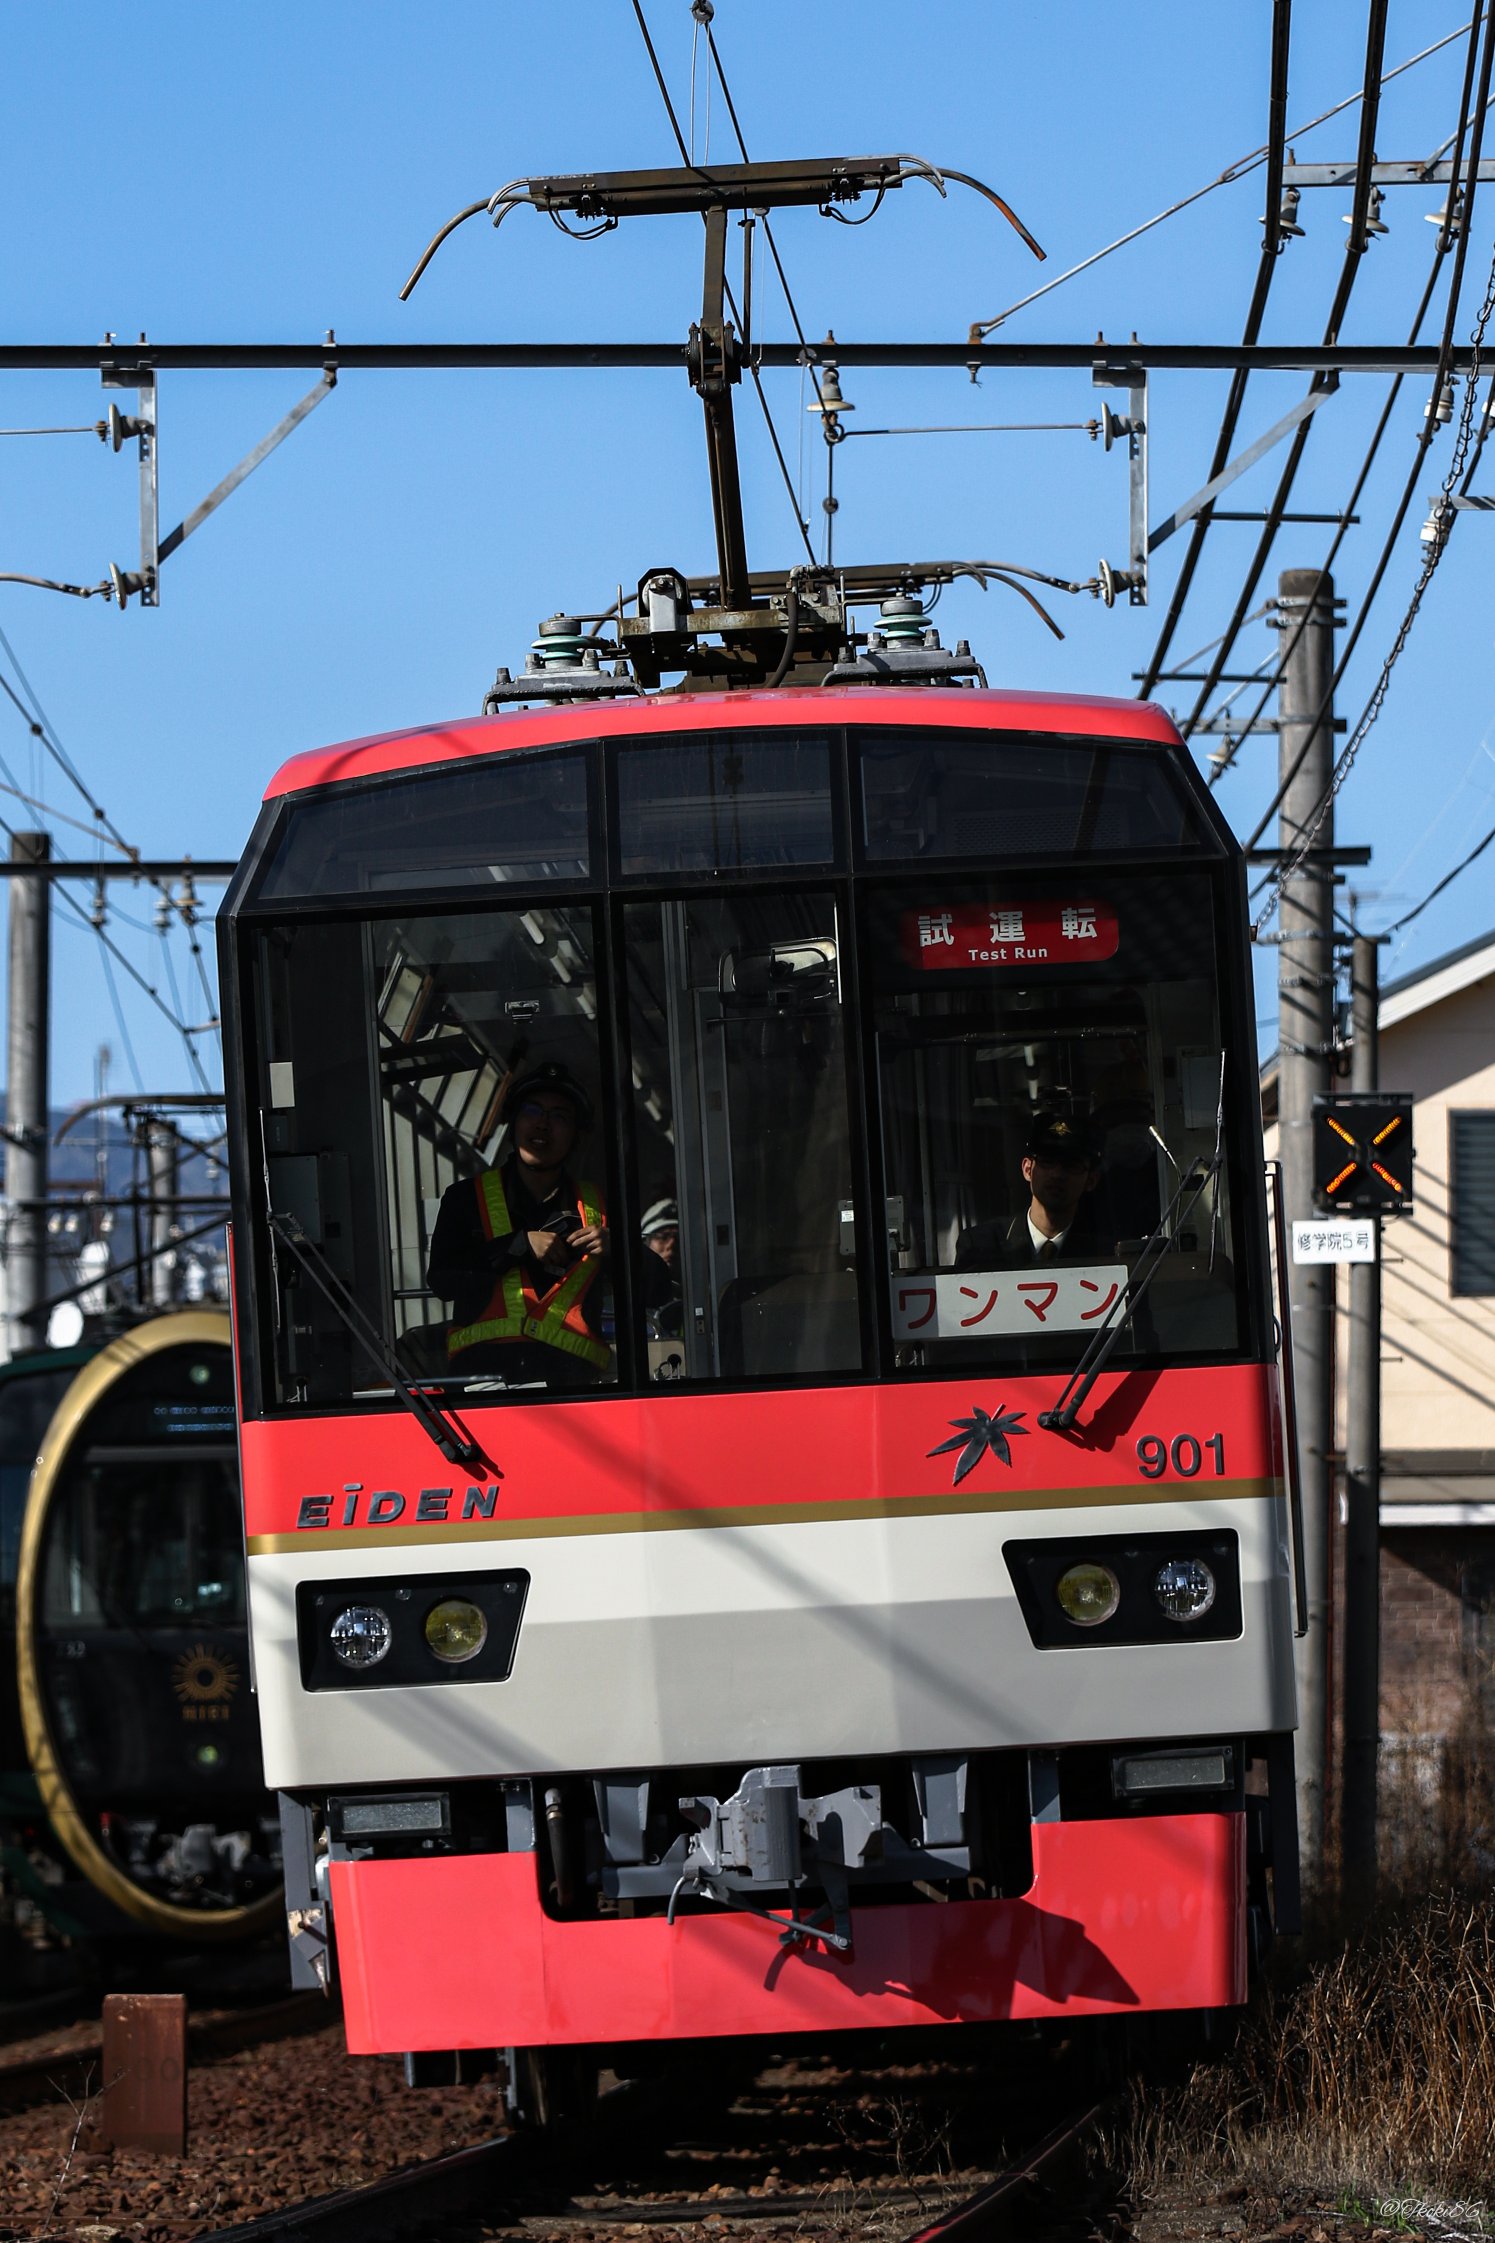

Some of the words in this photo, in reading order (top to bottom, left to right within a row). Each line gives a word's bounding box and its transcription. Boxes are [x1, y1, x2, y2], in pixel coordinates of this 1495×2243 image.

[917, 907, 1098, 947] 試運転
[968, 947, 1008, 961] Test
[1014, 946, 1049, 959] Run
[899, 1278, 1119, 1330] ワンマン
[1136, 1432, 1225, 1478] 901
